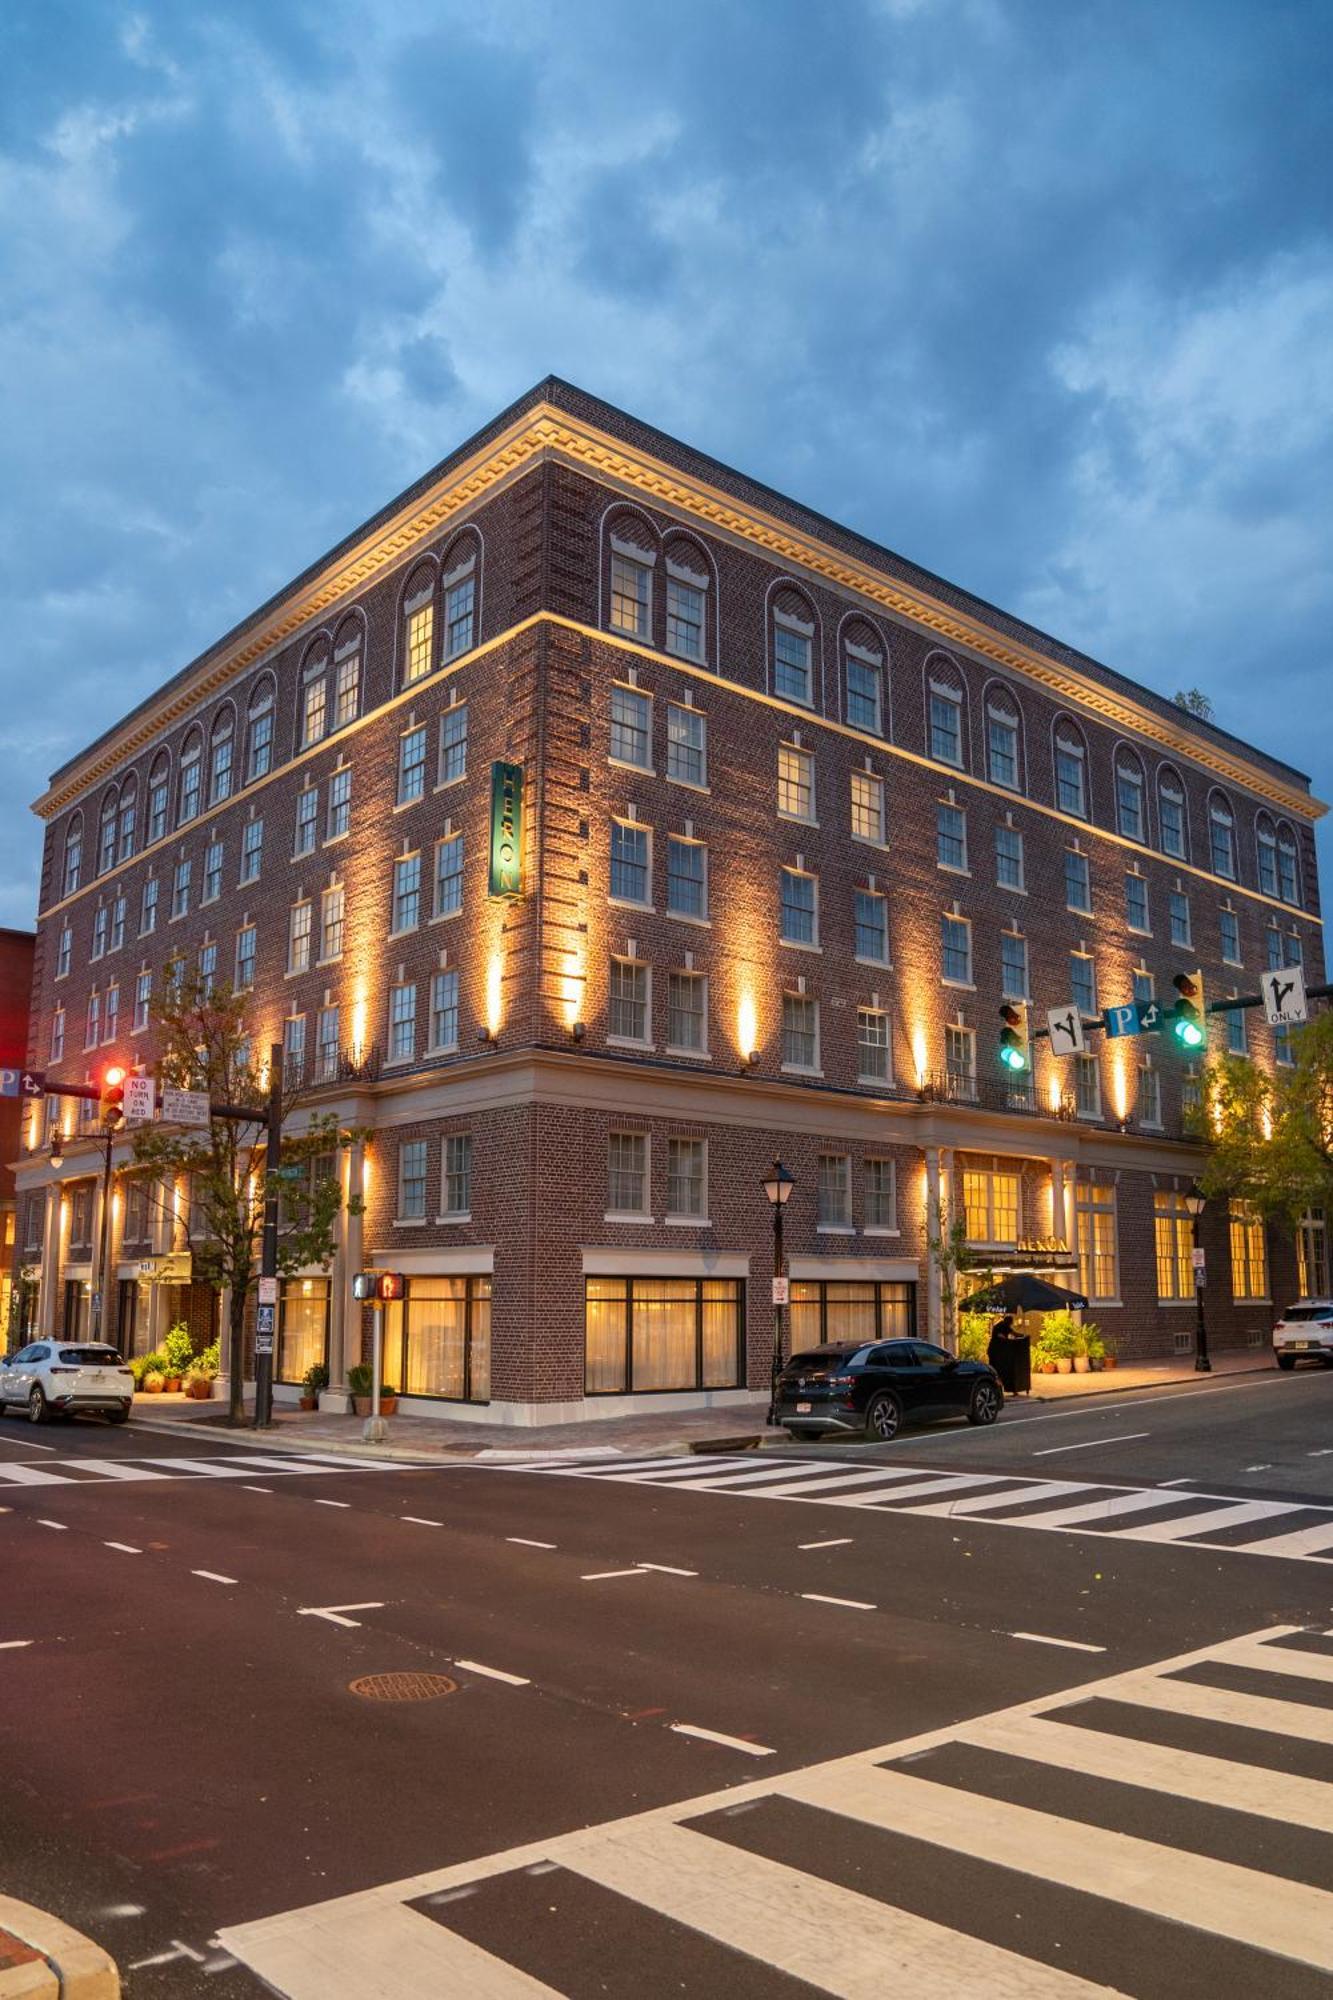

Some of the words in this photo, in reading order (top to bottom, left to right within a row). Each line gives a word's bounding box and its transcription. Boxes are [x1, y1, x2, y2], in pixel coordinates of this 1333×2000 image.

[1112, 1008, 1132, 1034] P
[1271, 1009, 1302, 1023] ONLY
[132, 1081, 147, 1089] NO
[129, 1090, 149, 1100] TURN
[131, 1108, 146, 1116] RED
